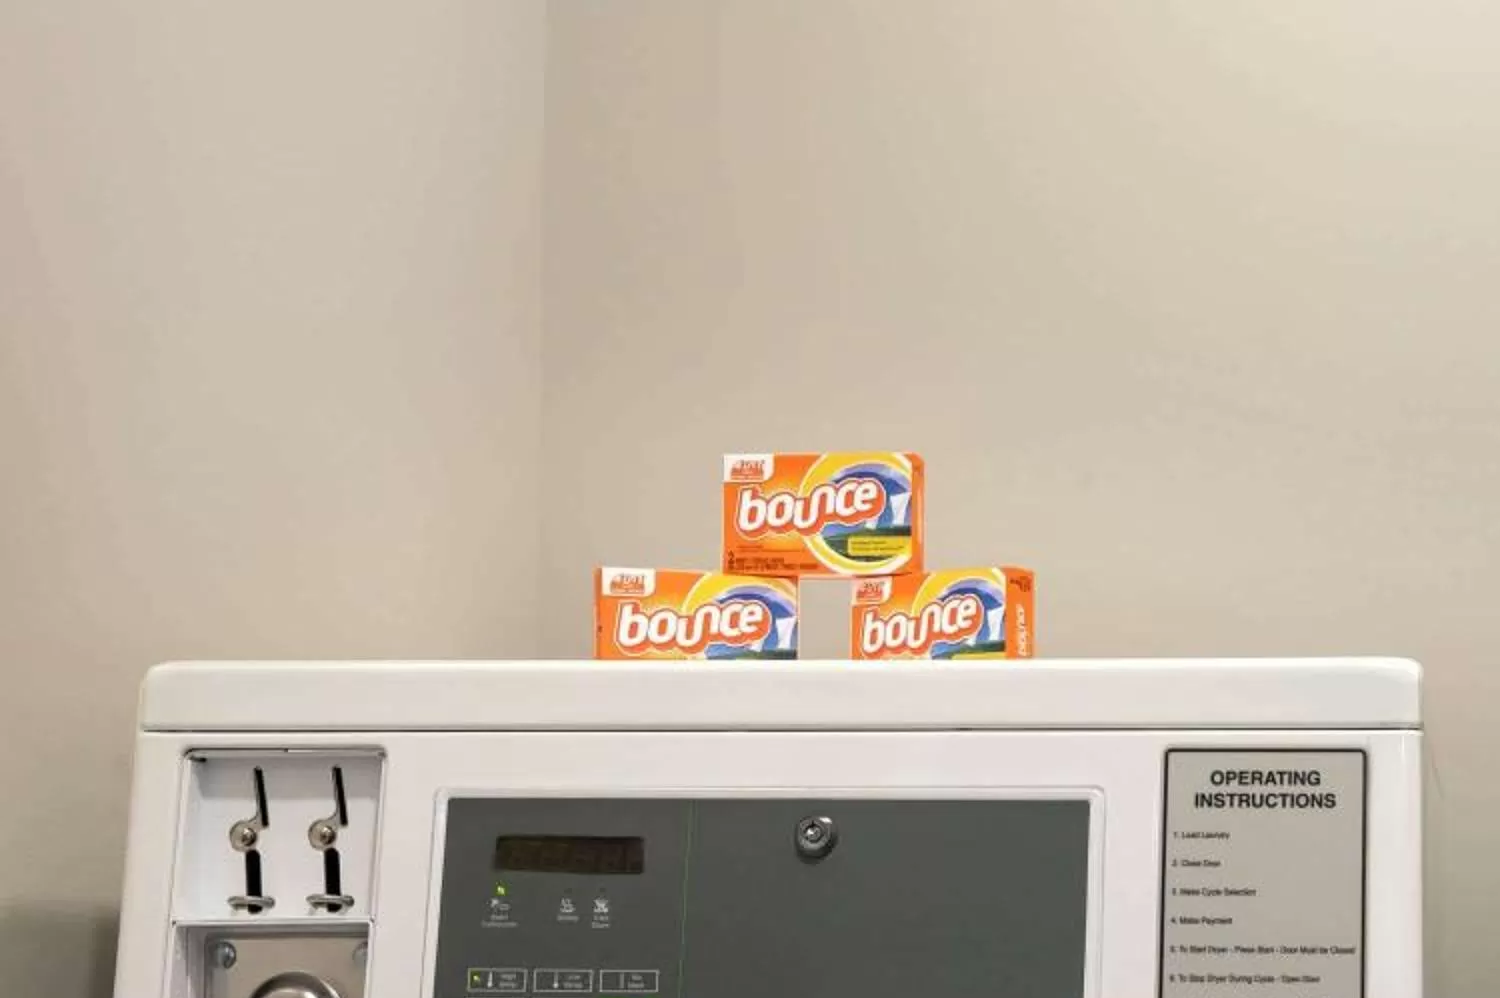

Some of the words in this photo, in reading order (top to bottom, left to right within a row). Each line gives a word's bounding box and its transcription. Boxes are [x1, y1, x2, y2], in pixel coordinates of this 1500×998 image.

[738, 481, 878, 532] bounce
[618, 601, 763, 647] bounce
[863, 598, 977, 653] bounce
[1194, 793, 1337, 809] INSTRUCTIONS
[1210, 770, 1321, 786] OPERATING
